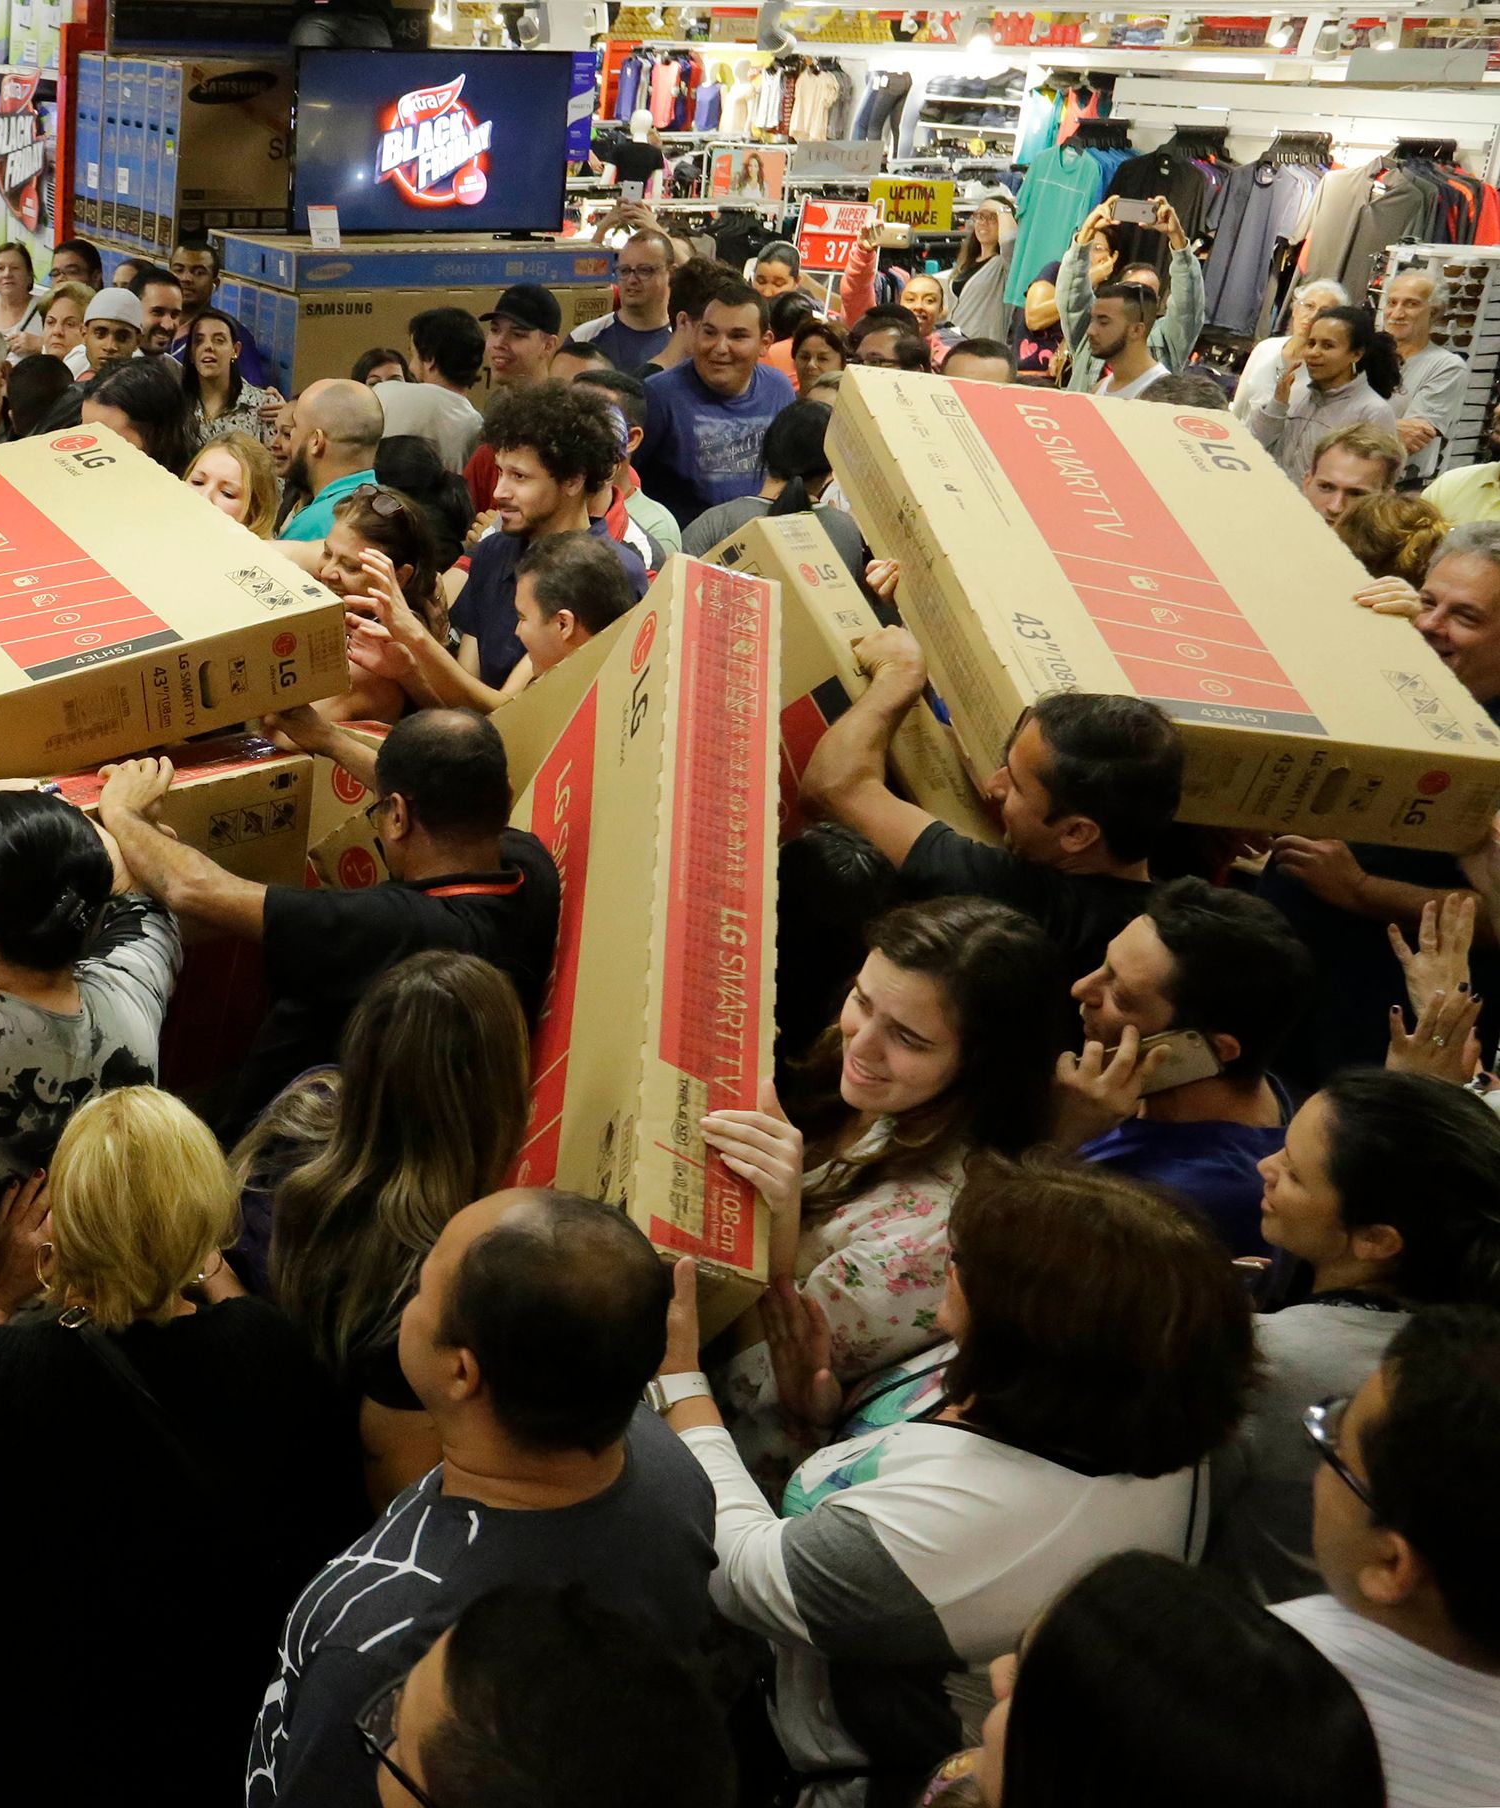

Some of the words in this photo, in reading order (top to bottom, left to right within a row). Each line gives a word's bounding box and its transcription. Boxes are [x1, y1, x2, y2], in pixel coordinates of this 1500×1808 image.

[381, 109, 467, 173] BLACK
[417, 120, 493, 191] FRIDAY
[4, 141, 45, 192] FRIDAY
[889, 185, 936, 200] ULTIMA
[837, 207, 867, 218] HIPER
[886, 210, 938, 225] CHANCE
[306, 302, 373, 316] SAMSUNG
[1013, 402, 1061, 430] LG
[71, 448, 117, 469] LG
[1034, 433, 1111, 504] SMART
[1198, 442, 1252, 472] LG
[1083, 506, 1134, 538] TV
[814, 563, 838, 581] LG
[75, 644, 133, 665] 43LH57
[178, 652, 190, 670] LG
[278, 659, 297, 689] LG
[153, 666, 172, 729] 43"/108cm
[180, 671, 195, 709] SMART
[630, 664, 651, 739] LG
[185, 710, 197, 727] TV
[1200, 708, 1268, 724] 43LH57
[1310, 750, 1328, 767] LG
[554, 759, 573, 825] LG
[1403, 799, 1435, 827] LG
[719, 907, 748, 947] LG
[715, 950, 749, 1050] SMART
[713, 1054, 743, 1097] TV
[676, 1078, 689, 1119] TRIPLE
